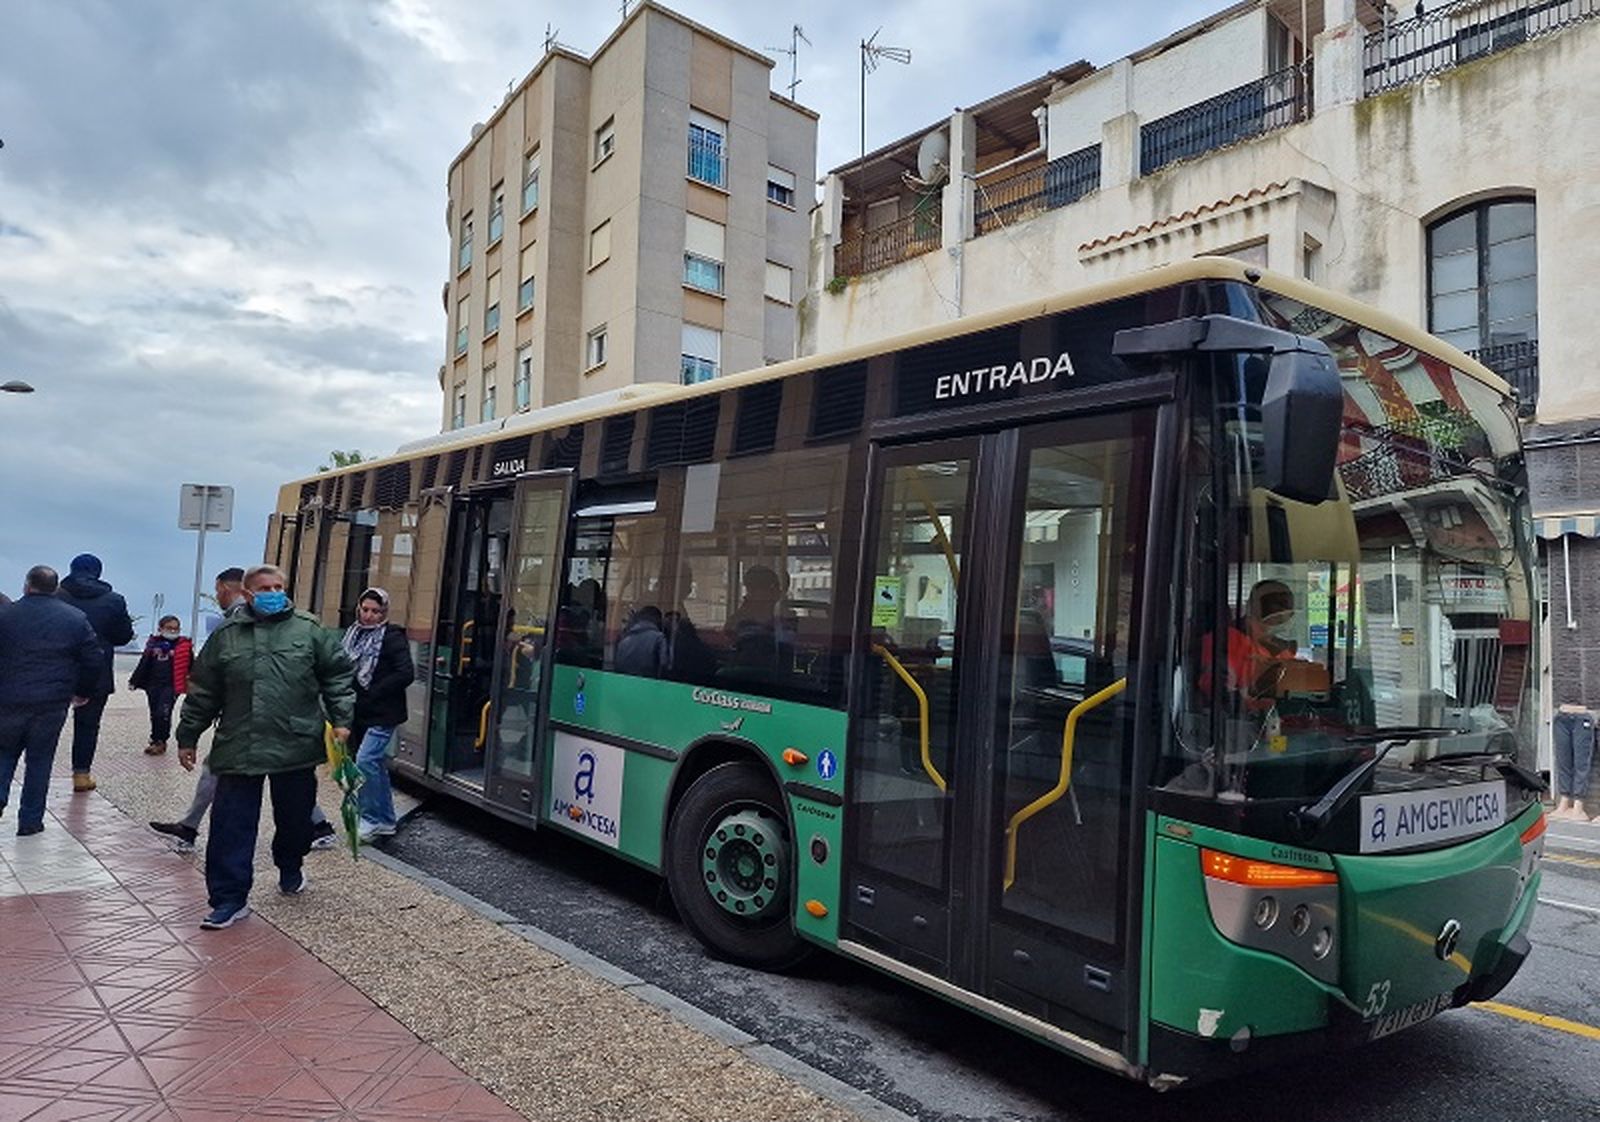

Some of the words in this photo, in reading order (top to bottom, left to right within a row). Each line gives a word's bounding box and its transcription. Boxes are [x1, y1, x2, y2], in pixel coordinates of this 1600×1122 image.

[935, 352, 1075, 399] ENTRADA
[493, 459, 525, 476] SALIDA
[552, 798, 617, 838] AMVICESA
[1395, 793, 1499, 837] AMGEVICESA
[1362, 979, 1391, 1018] 53
